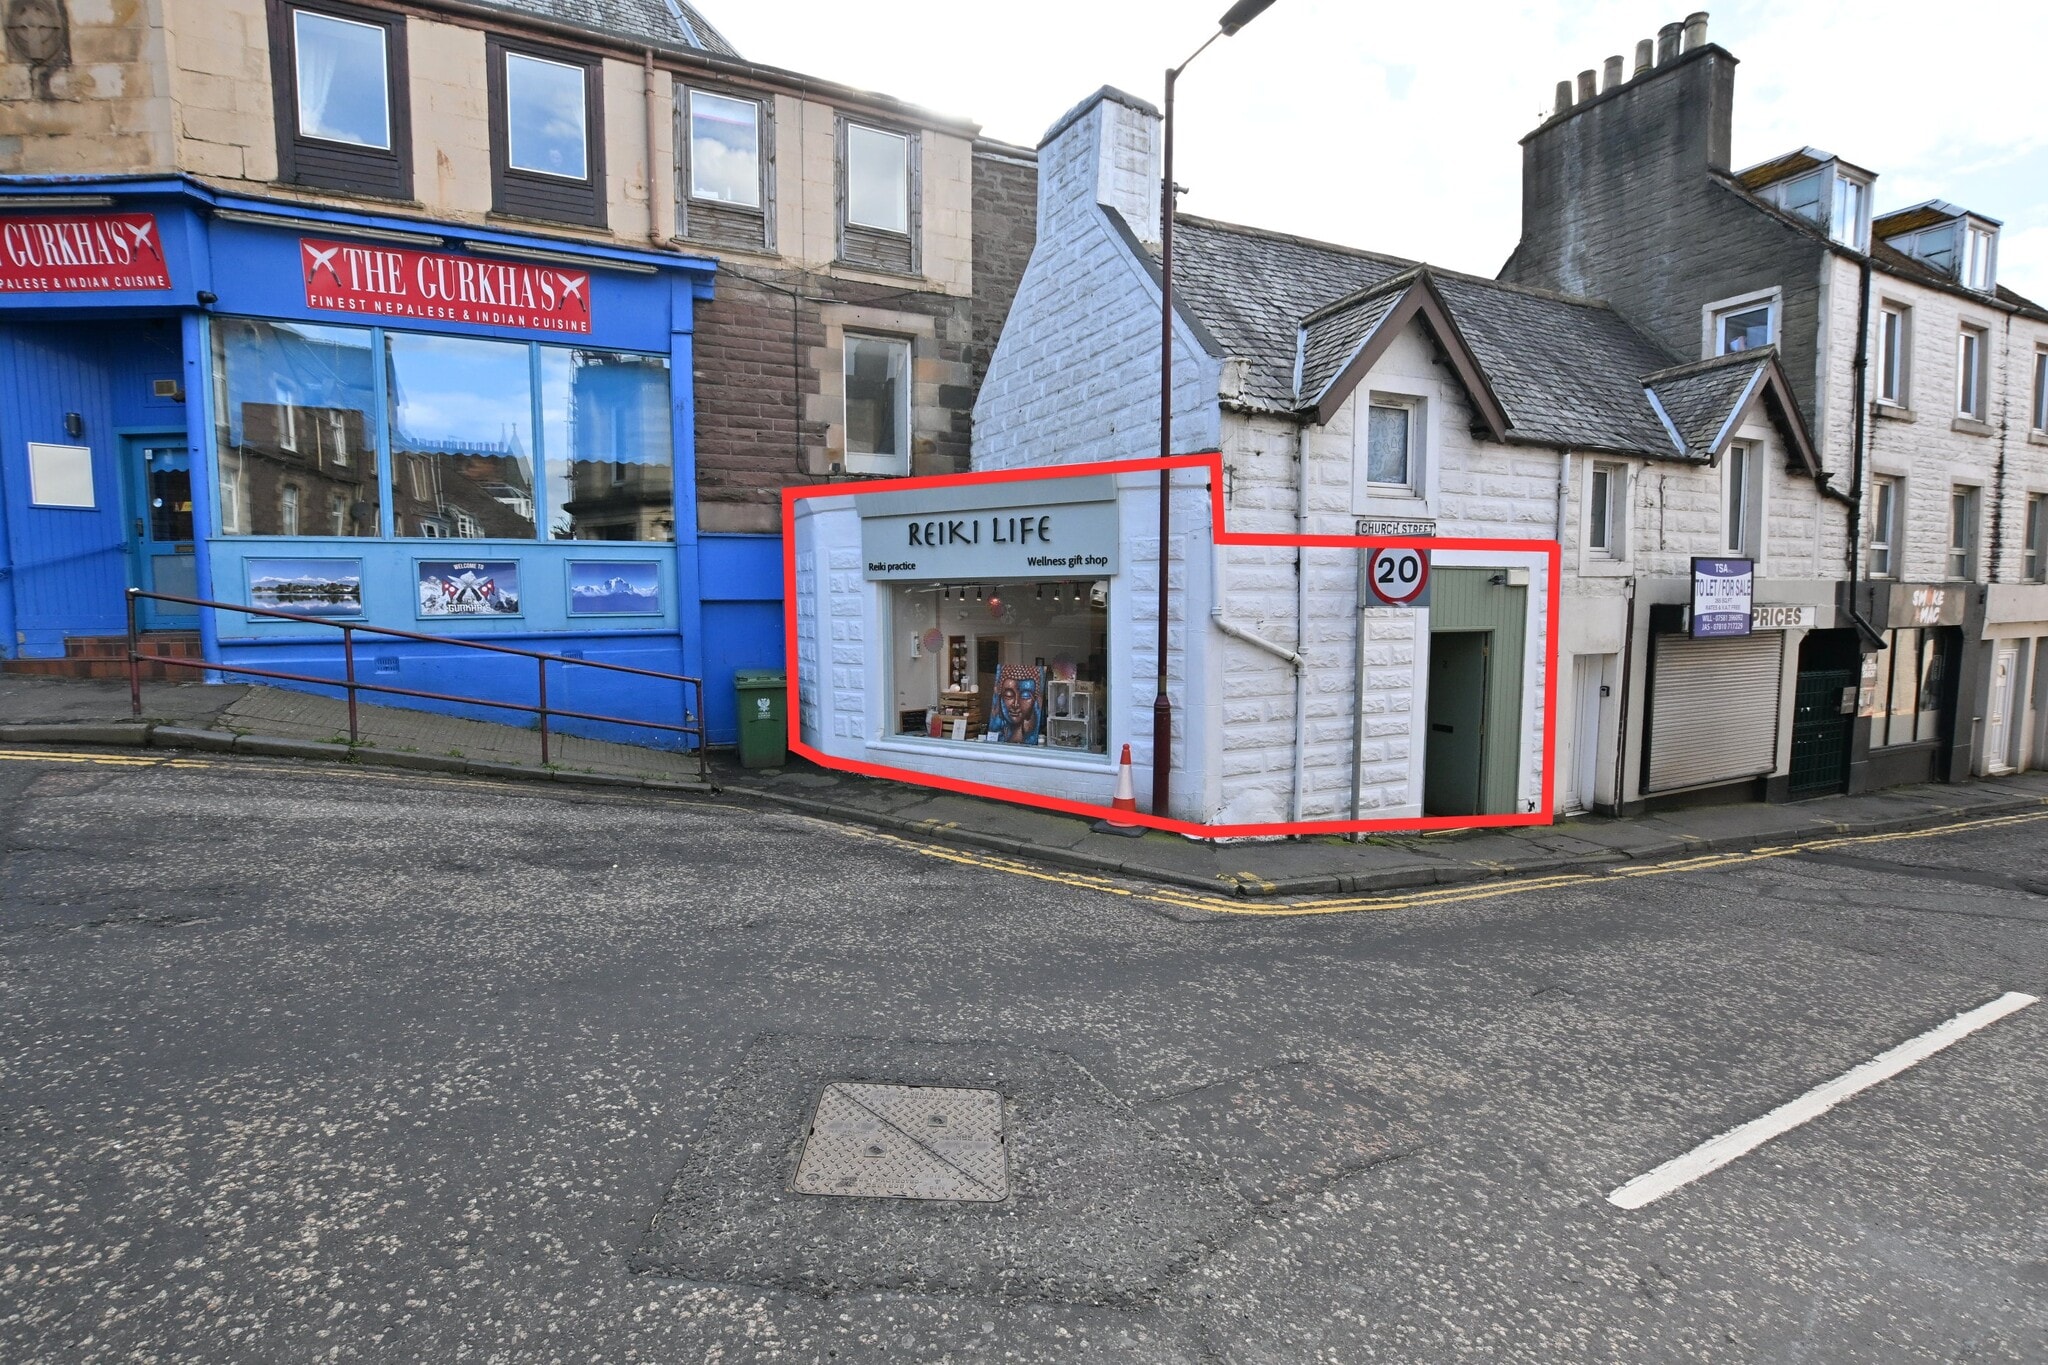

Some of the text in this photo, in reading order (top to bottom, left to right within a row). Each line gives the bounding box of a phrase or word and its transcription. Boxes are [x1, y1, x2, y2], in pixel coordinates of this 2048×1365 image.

[4, 221, 131, 267] GURKHA'S
[54, 277, 61, 289] &
[65, 277, 110, 288] INDIAN
[114, 275, 165, 288] CUISINE
[343, 247, 555, 311] THE GURKHA'S
[310, 294, 588, 332] FINEST NEPALESE & INDIAN CUISINE
[908, 515, 1051, 547] REIKI LIFE
[1361, 522, 1434, 534] CHURCH STREET
[868, 561, 916, 573] Reiki practice
[1027, 554, 1108, 569] Wellness gift shop
[1378, 555, 1419, 584] 20
[1715, 564, 1728, 573] TSA
[1696, 579, 1704, 597] TO
[1706, 579, 1717, 597] LET
[1722, 579, 1734, 597] FOR
[1735, 579, 1751, 597] SALE
[1753, 607, 1802, 626] PRICES
